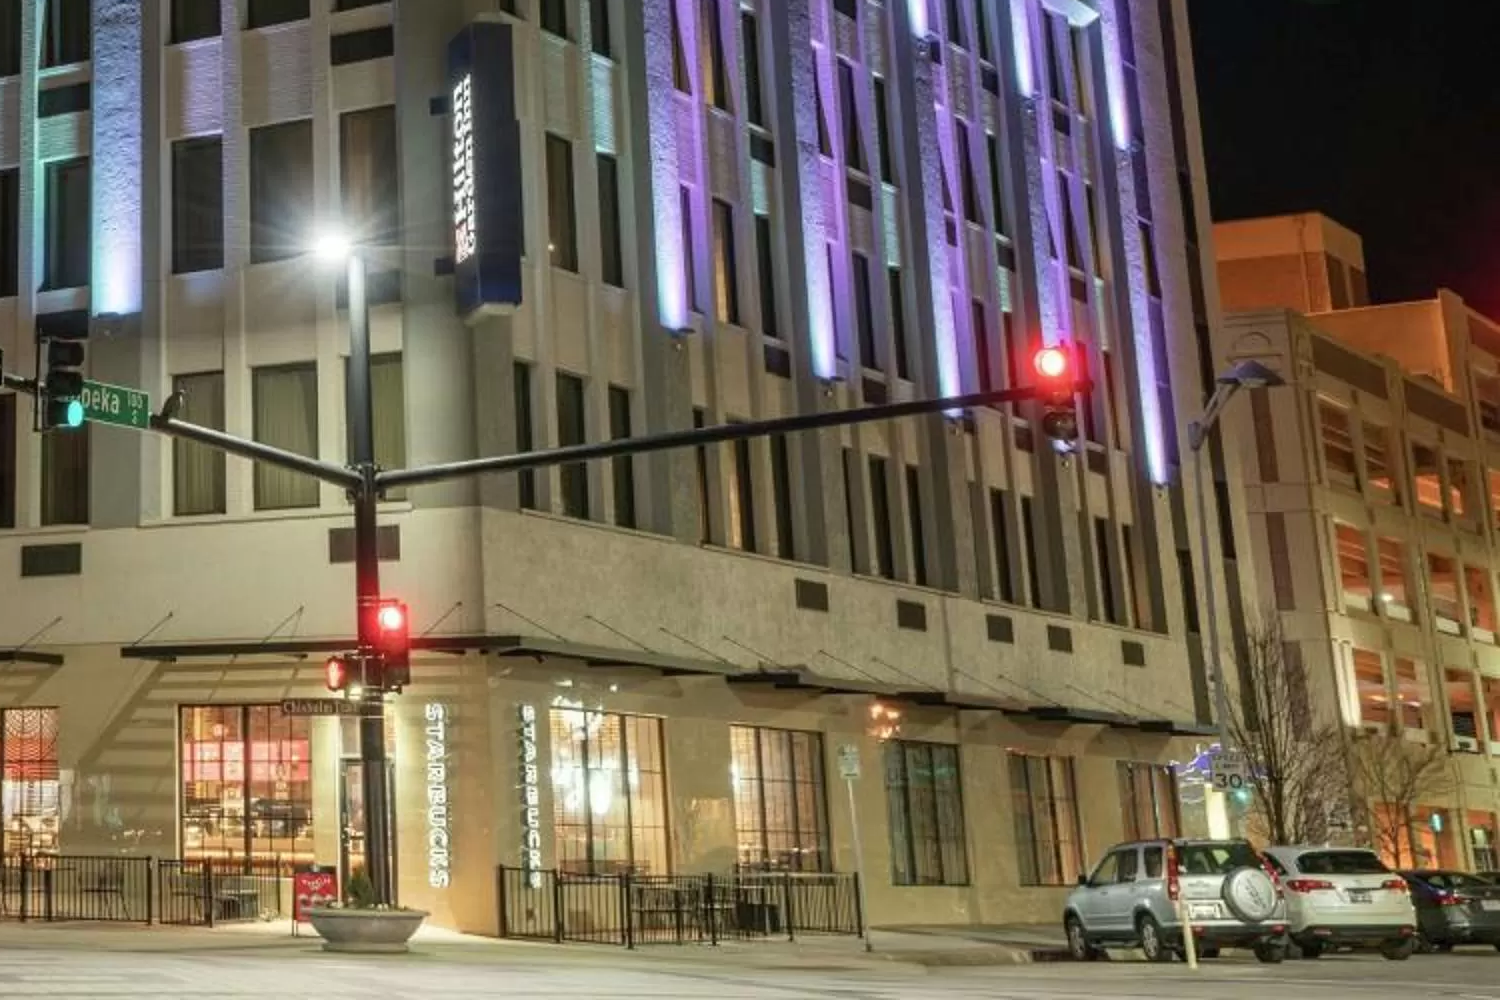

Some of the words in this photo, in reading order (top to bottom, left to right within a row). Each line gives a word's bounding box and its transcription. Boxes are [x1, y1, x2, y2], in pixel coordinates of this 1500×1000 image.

[453, 81, 467, 226] Hilton
[81, 387, 120, 415] peka
[425, 703, 449, 888] STARBUCKS
[522, 704, 541, 889] STARBUCKS
[1214, 773, 1242, 789] 30
